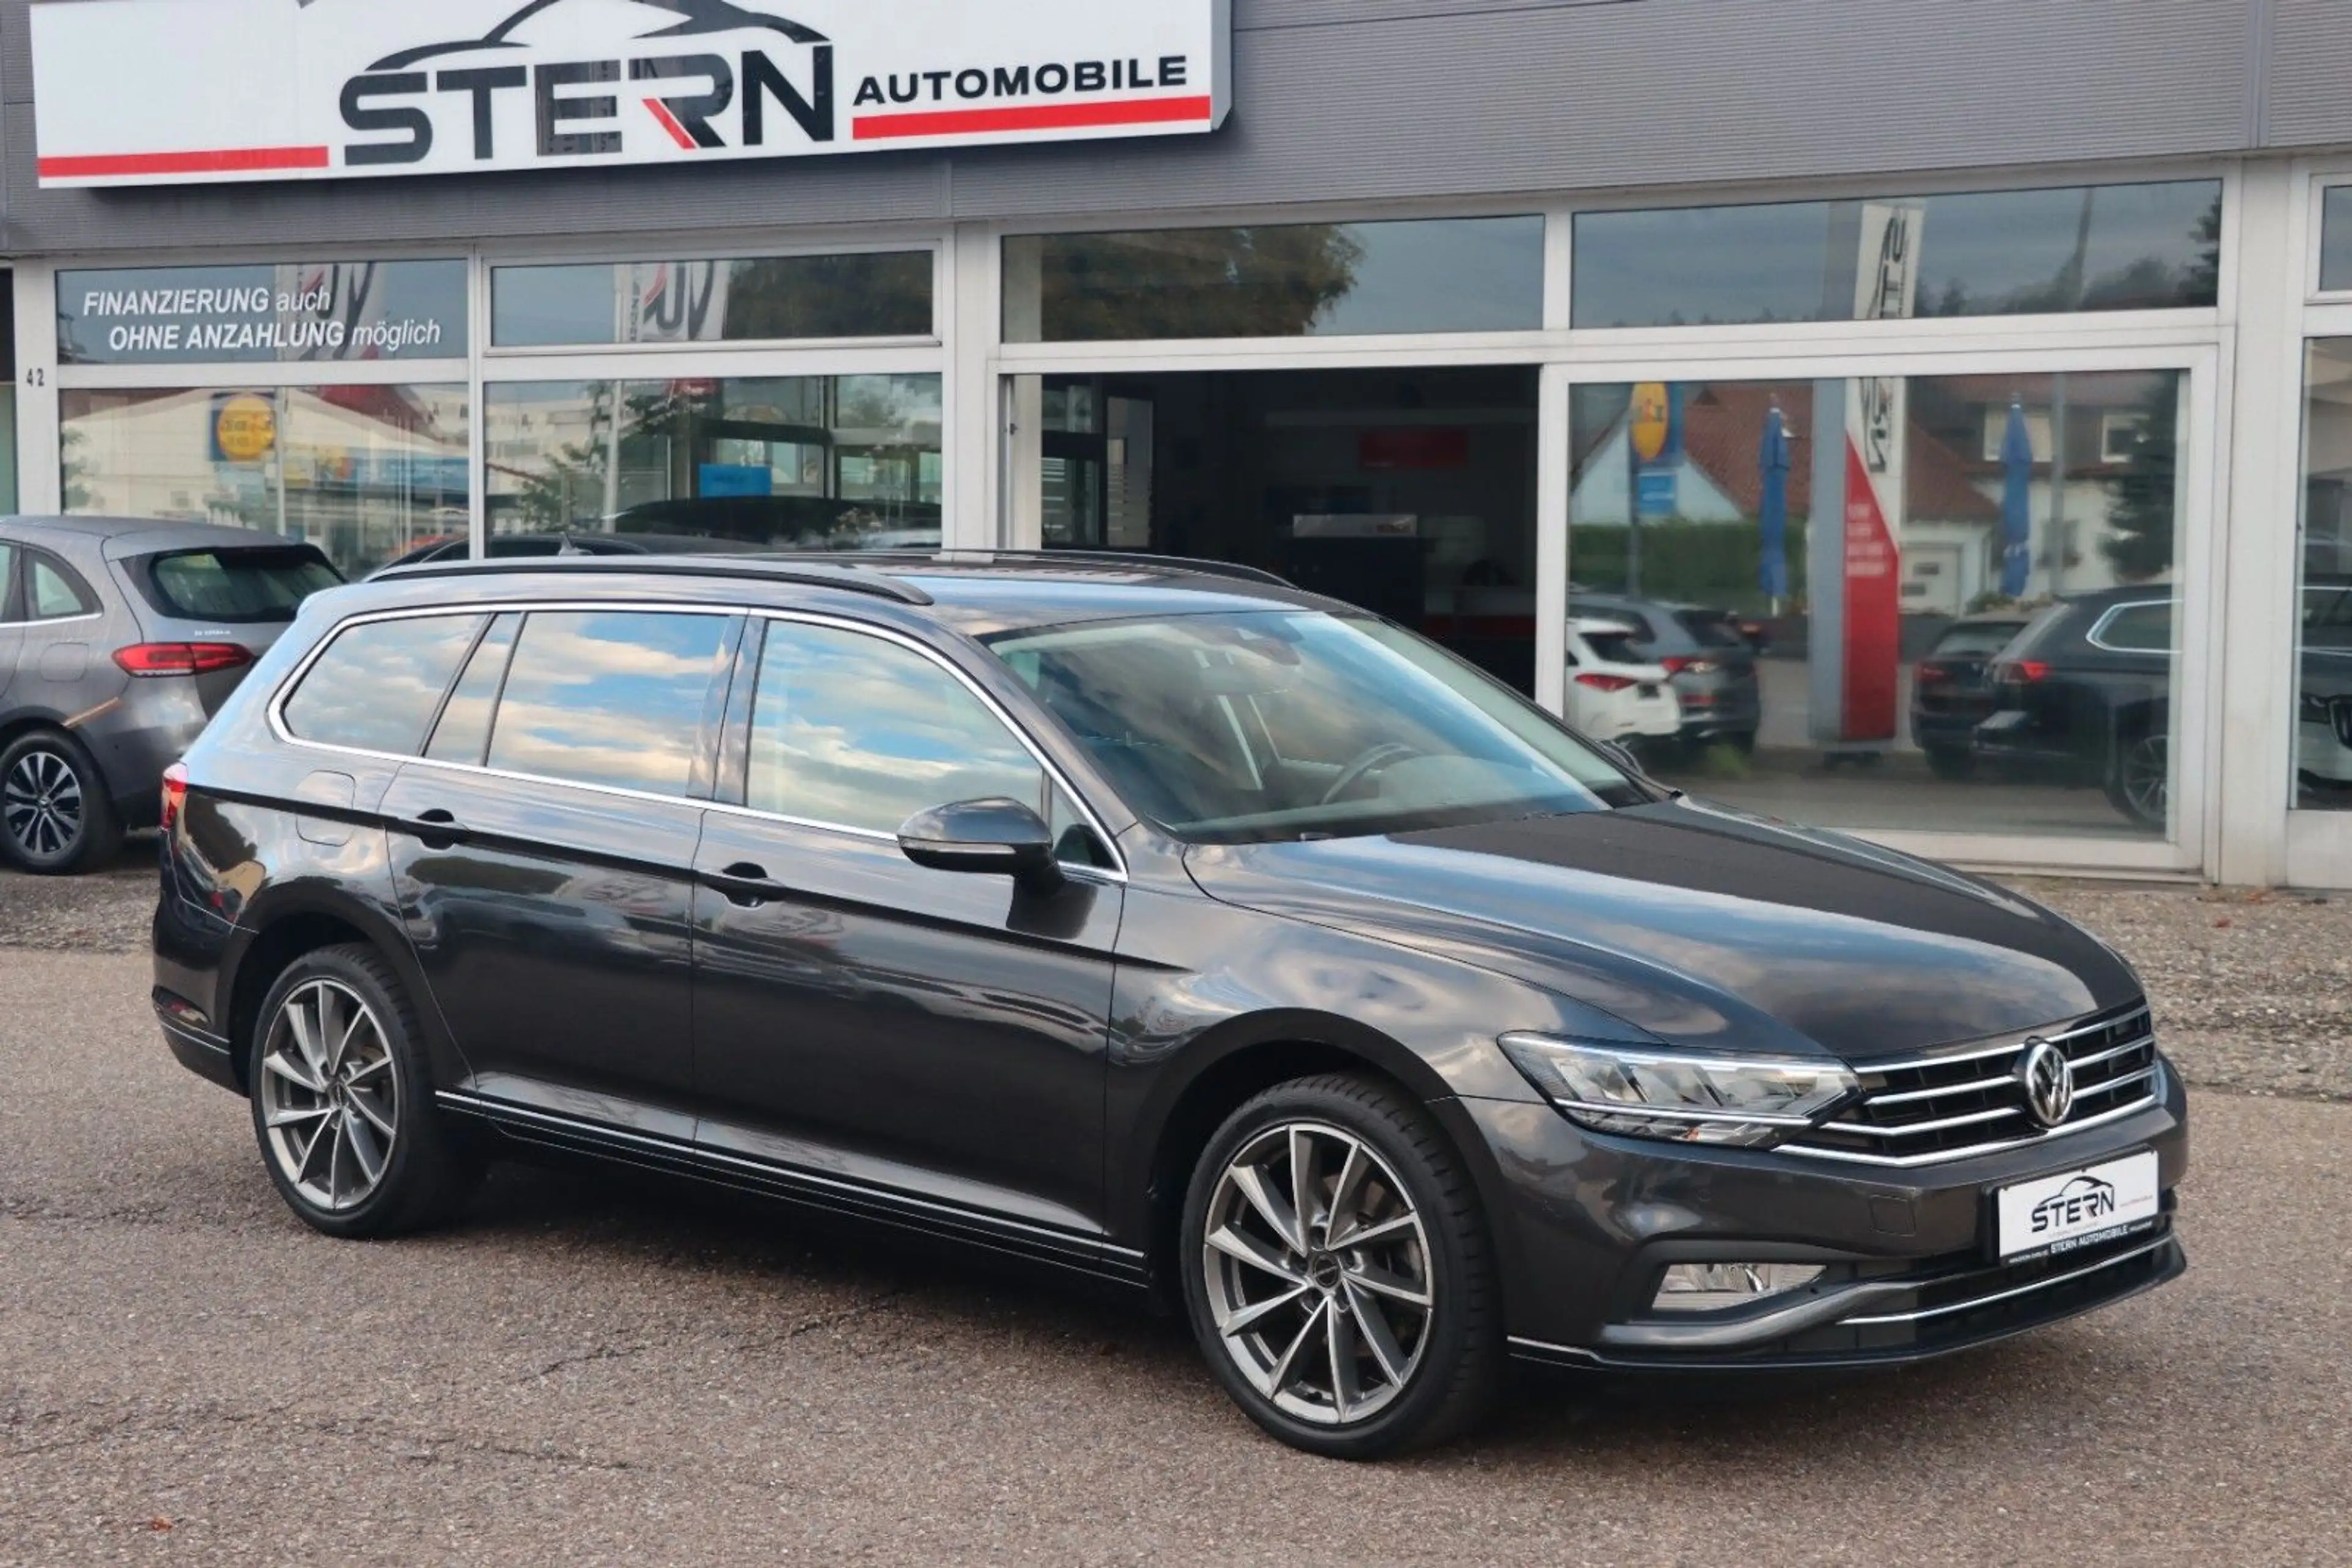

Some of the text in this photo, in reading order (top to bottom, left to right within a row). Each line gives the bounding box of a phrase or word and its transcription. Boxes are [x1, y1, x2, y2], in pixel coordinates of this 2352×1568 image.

[339, 44, 1186, 166] STERN AUTOMOBILE
[83, 285, 331, 316] FINANZIERUNG auch
[109, 318, 441, 352] OHNE ANZAHLUNG möglich
[2031, 1188, 2115, 1233] STERN
[2051, 1238, 2078, 1254] STERN
[2078, 1225, 2129, 1246] AUTOMOBILE
